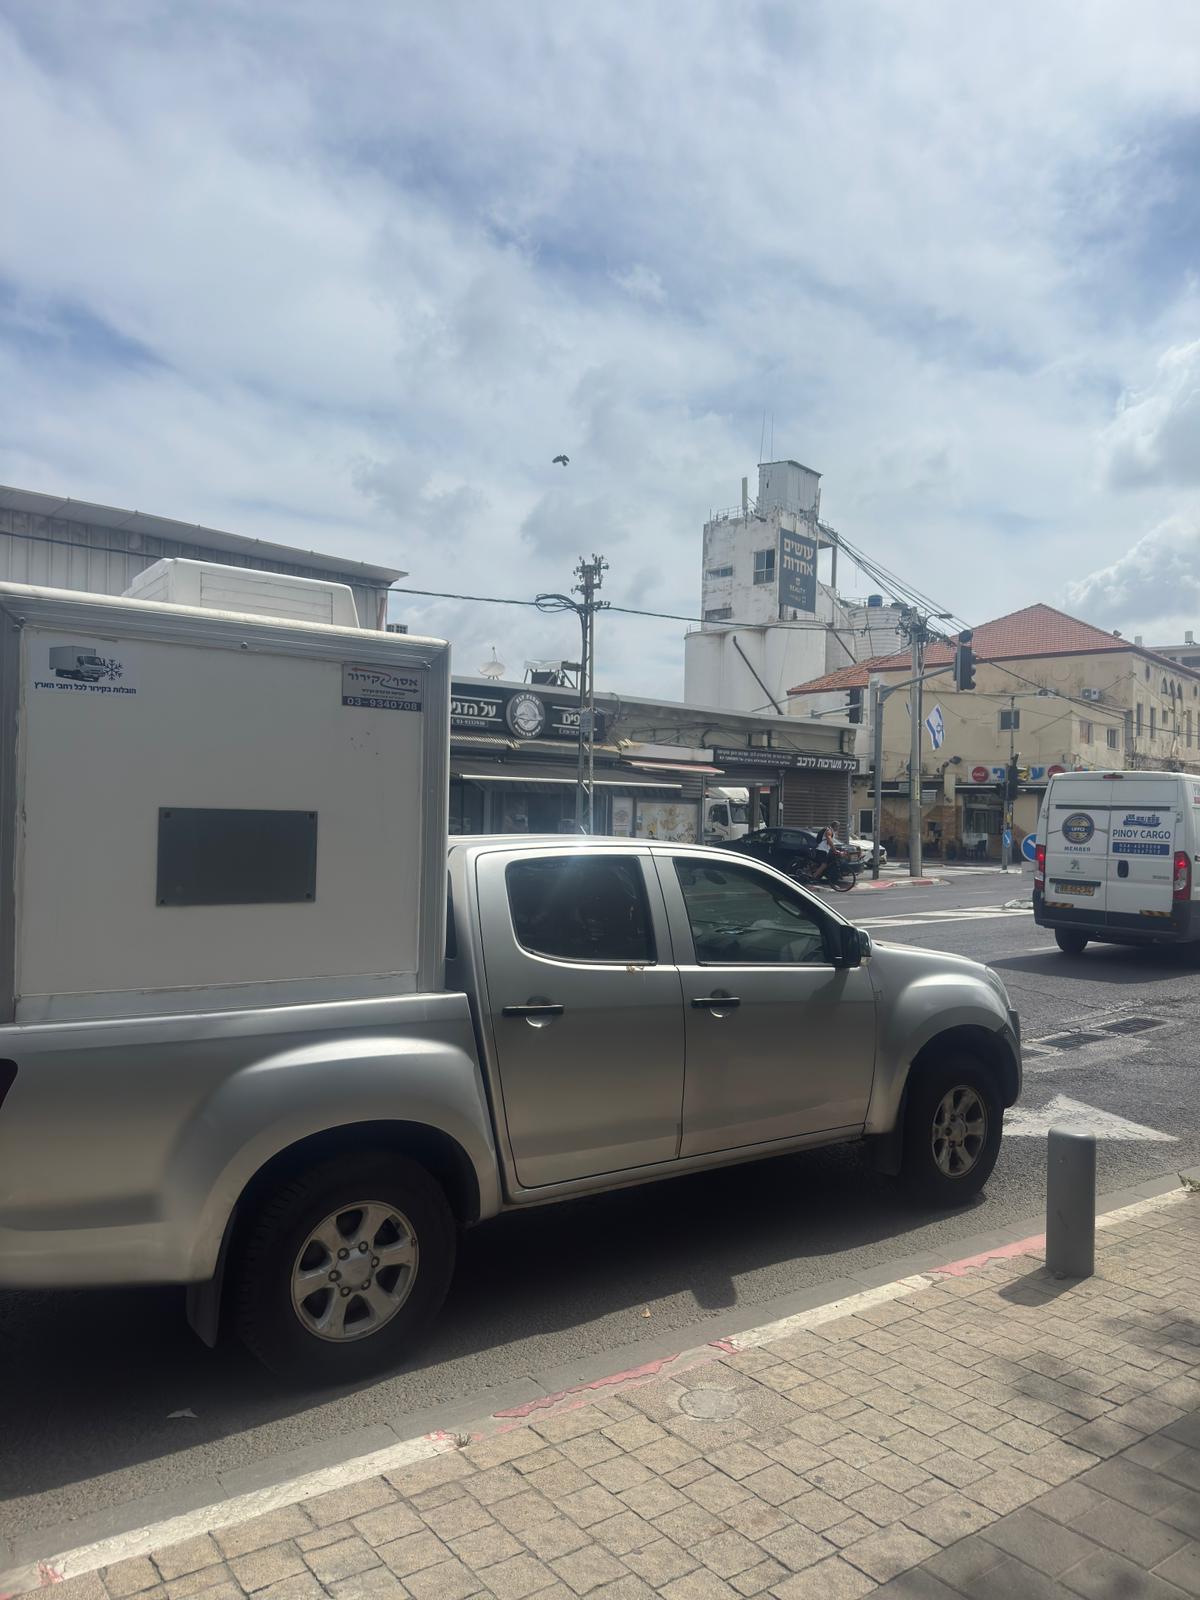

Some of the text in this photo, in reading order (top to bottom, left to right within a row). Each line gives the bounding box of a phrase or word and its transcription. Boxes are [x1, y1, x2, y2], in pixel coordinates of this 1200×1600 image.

[784, 538, 814, 560] עושים
[783, 555, 814, 576] אחדות
[348, 673, 418, 687] אסף קירור
[34, 681, 137, 694] הובלות בקירור לכל רחבי הארץ
[347, 697, 418, 710] 03-9340708
[451, 701, 496, 717] על הדגי
[797, 757, 816, 767] לרכב
[817, 758, 842, 770] מערכות
[1112, 829, 1171, 839] PINOY CARGO
